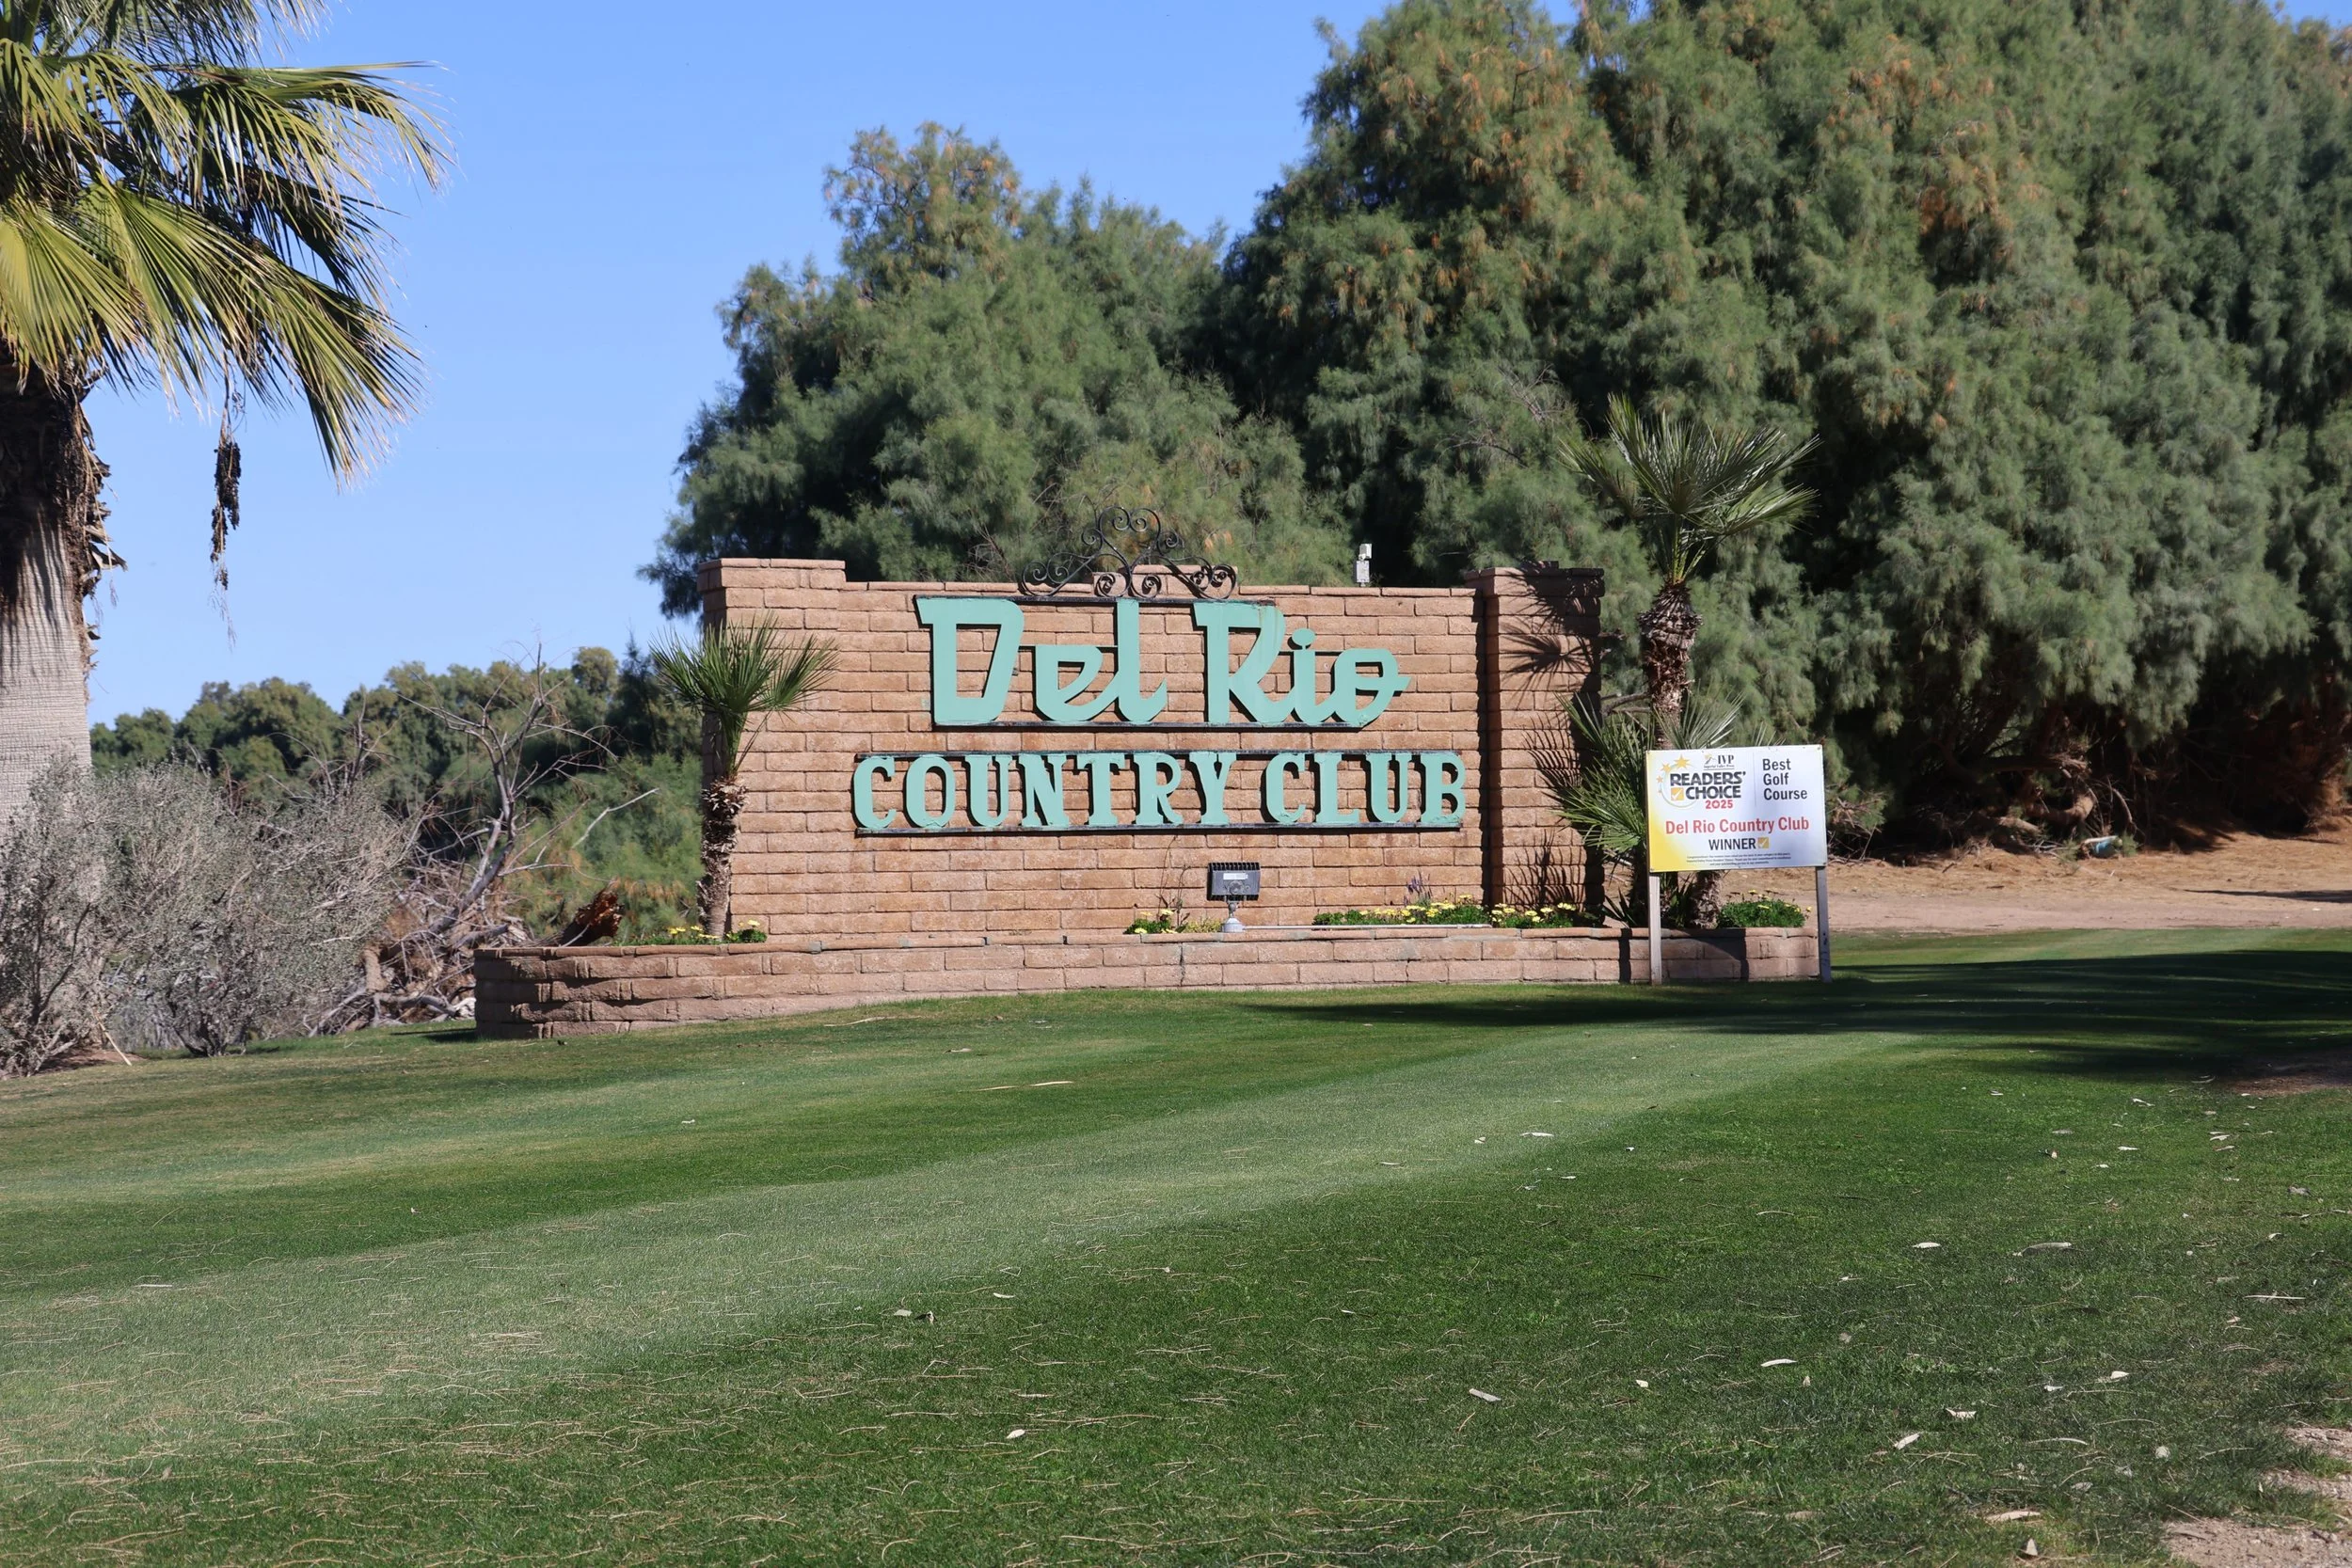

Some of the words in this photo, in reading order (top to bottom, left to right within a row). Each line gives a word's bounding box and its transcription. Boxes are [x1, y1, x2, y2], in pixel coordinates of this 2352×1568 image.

[915, 597, 1167, 724] Del
[1194, 601, 1411, 724] Rio
[1718, 754, 1734, 765] IVP
[1762, 758, 1791, 770] Best
[1670, 771, 1746, 786] READERS'
[1763, 772, 1789, 785] Golf
[853, 752, 1235, 829] COUNTRY
[1264, 752, 1466, 826] CLUB
[1685, 785, 1741, 800] CHOICE
[1764, 787, 1807, 800] Course
[1705, 800, 1734, 809] 2025
[1665, 820, 1689, 834] Del
[1692, 819, 1715, 833] Rio
[1720, 818, 1774, 833] Country
[1778, 816, 1809, 831] Club
[1708, 838, 1756, 850] WINNER
